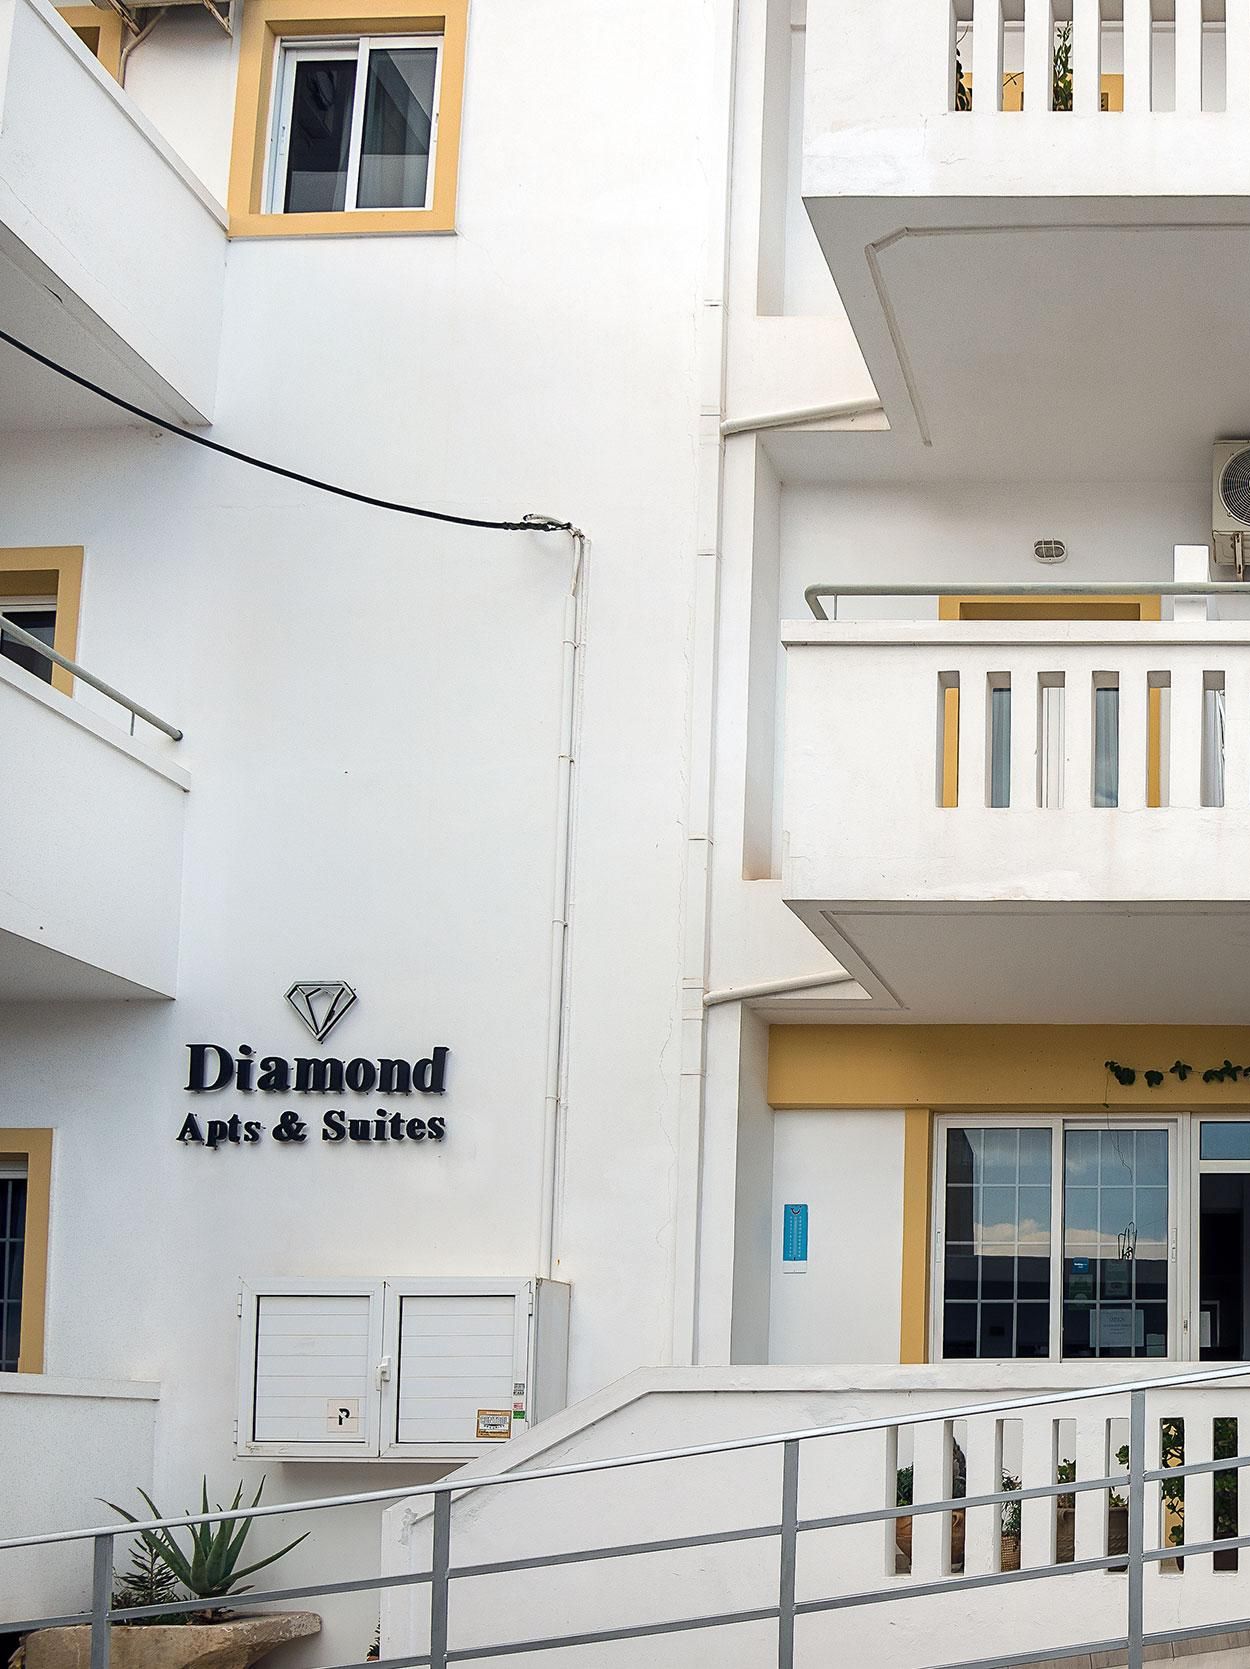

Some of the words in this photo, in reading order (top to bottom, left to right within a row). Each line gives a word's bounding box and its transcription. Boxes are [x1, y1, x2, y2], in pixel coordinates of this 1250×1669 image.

[183, 1043, 450, 1094] Diamond
[175, 1112, 263, 1148] Apts
[271, 1110, 308, 1142] &
[321, 1108, 446, 1142] Suites
